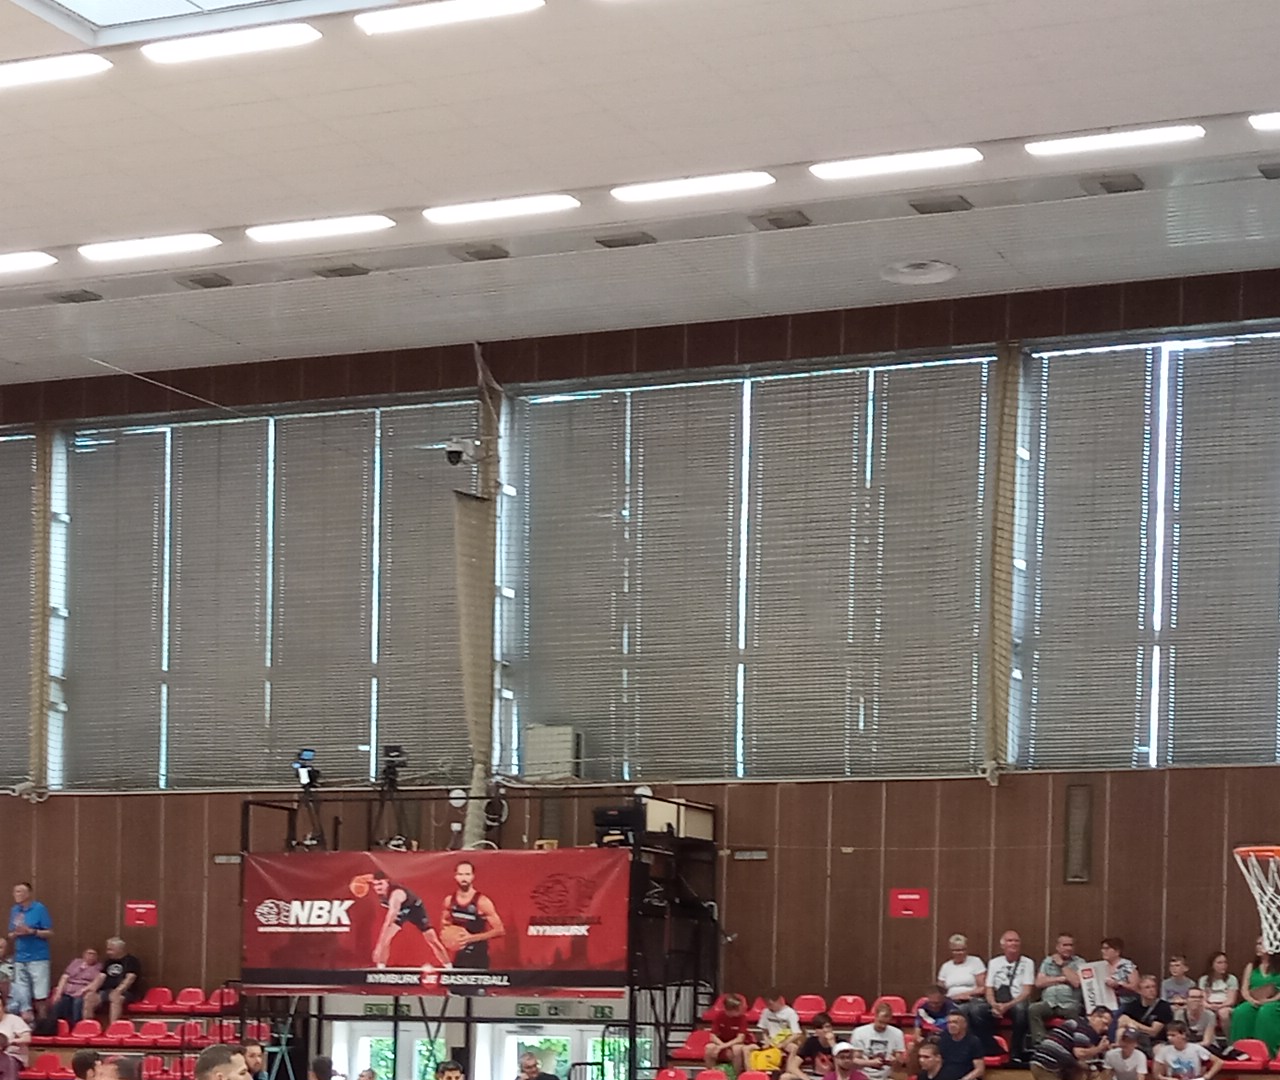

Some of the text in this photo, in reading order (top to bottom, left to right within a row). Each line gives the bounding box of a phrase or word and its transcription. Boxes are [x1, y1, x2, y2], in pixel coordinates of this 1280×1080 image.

[288, 900, 355, 925] NBK
[366, 973, 419, 984] NYMBURK
[439, 975, 510, 985] BASKETBALL
